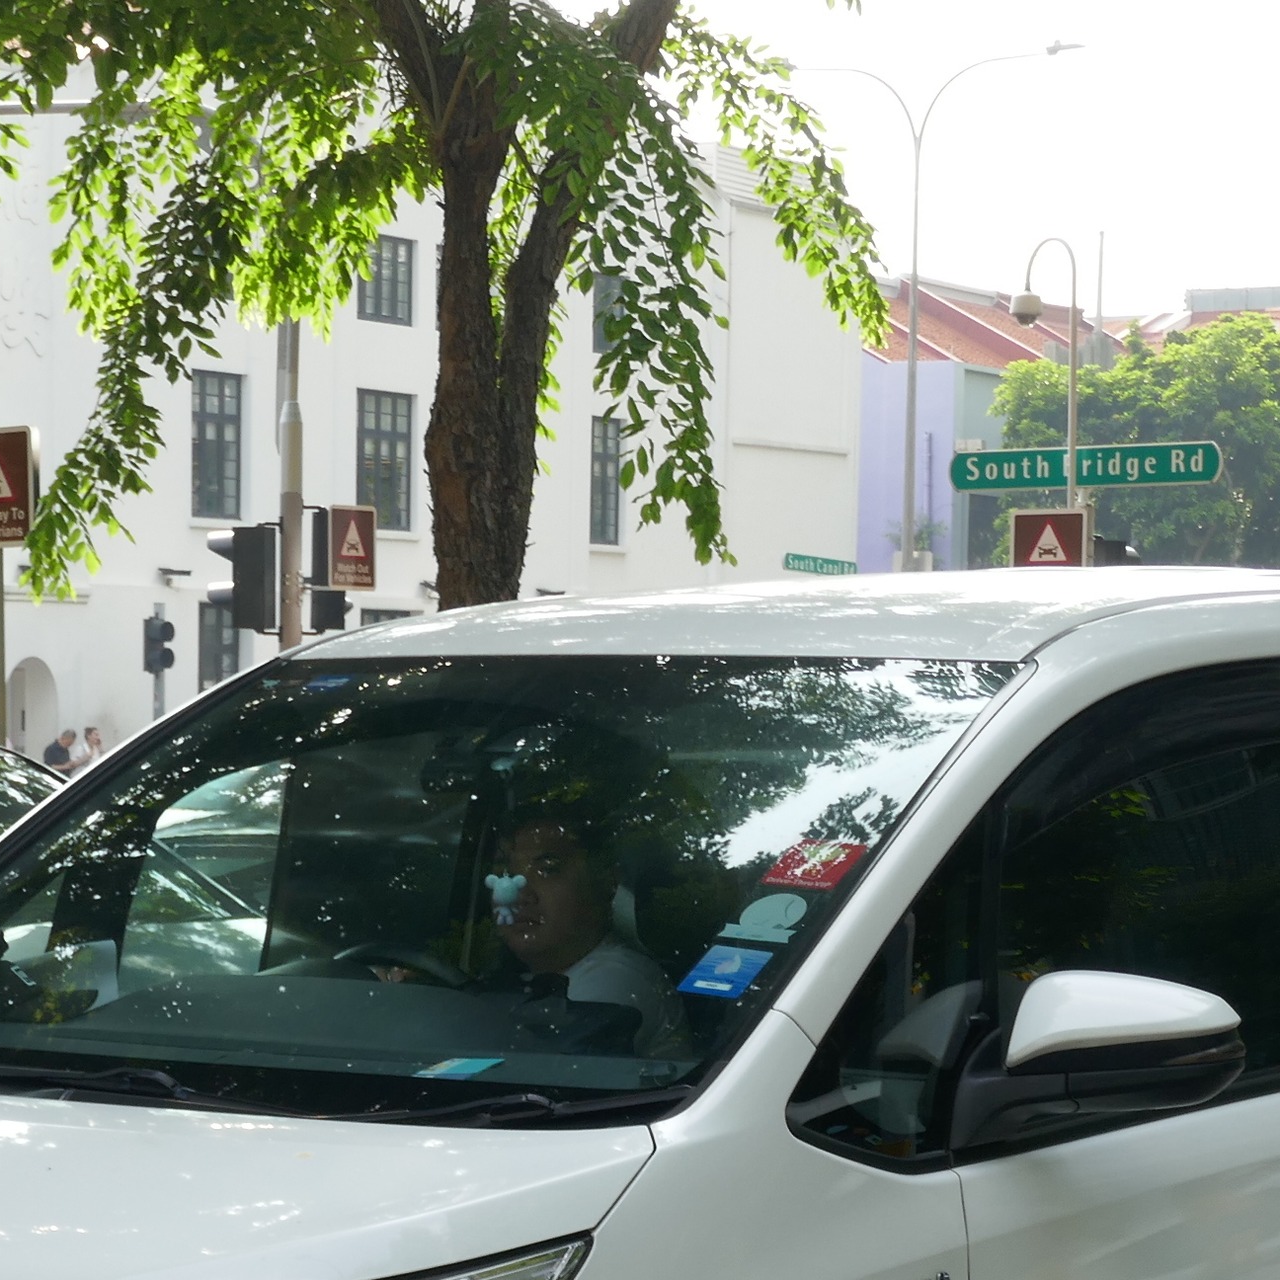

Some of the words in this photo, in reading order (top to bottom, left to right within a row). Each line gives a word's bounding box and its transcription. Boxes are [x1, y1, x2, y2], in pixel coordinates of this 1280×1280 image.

[965, 455, 1050, 481] South
[1171, 449, 1204, 473] Rd
[11, 507, 25, 520] To
[788, 554, 815, 572] South
[816, 559, 842, 575] Canal
